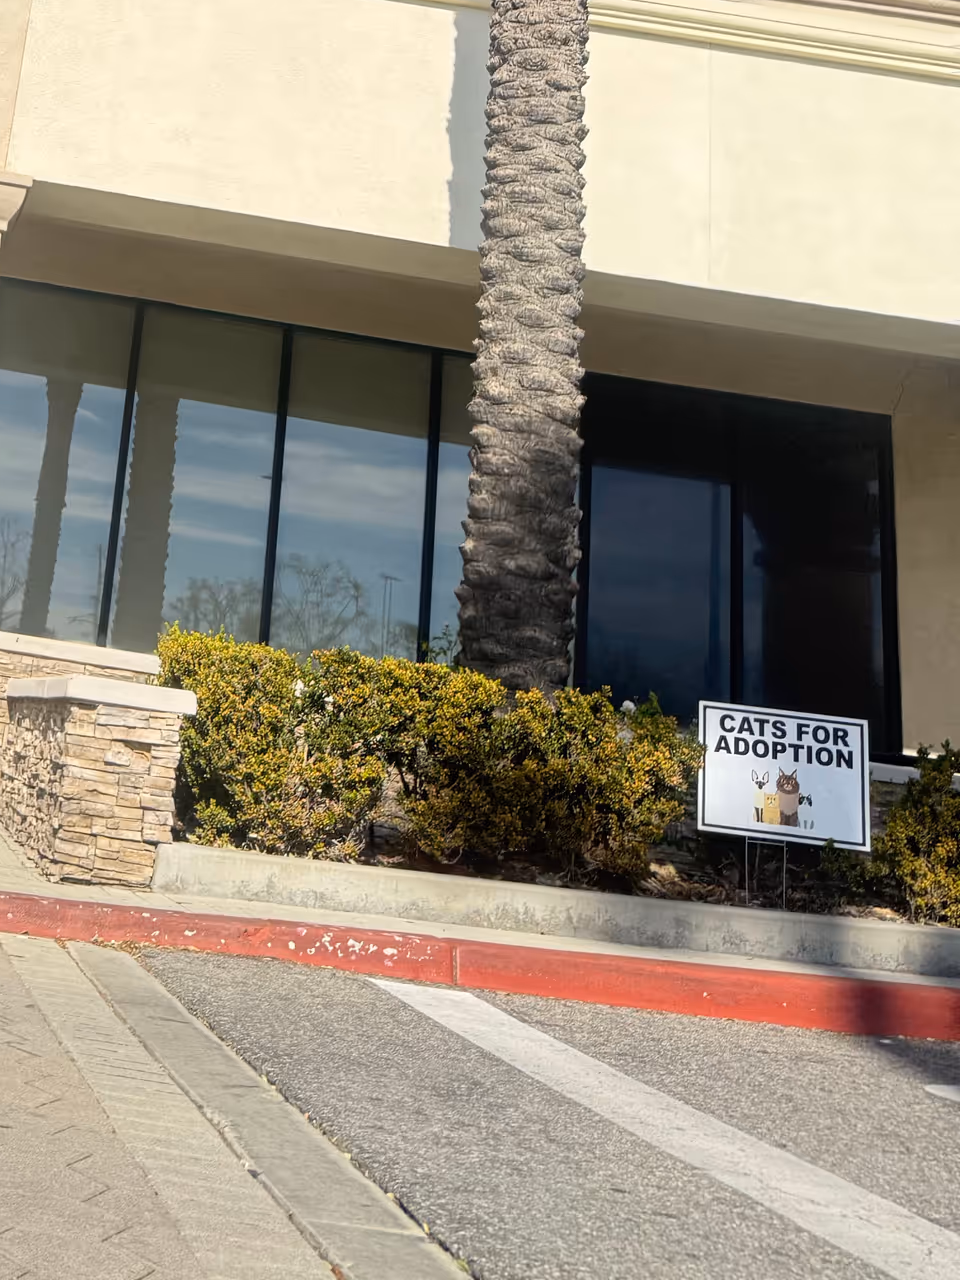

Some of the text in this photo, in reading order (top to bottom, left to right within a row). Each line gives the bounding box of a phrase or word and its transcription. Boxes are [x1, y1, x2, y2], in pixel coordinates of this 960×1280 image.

[719, 714, 850, 747] CATS FOR
[714, 735, 853, 769] ADOPTION
